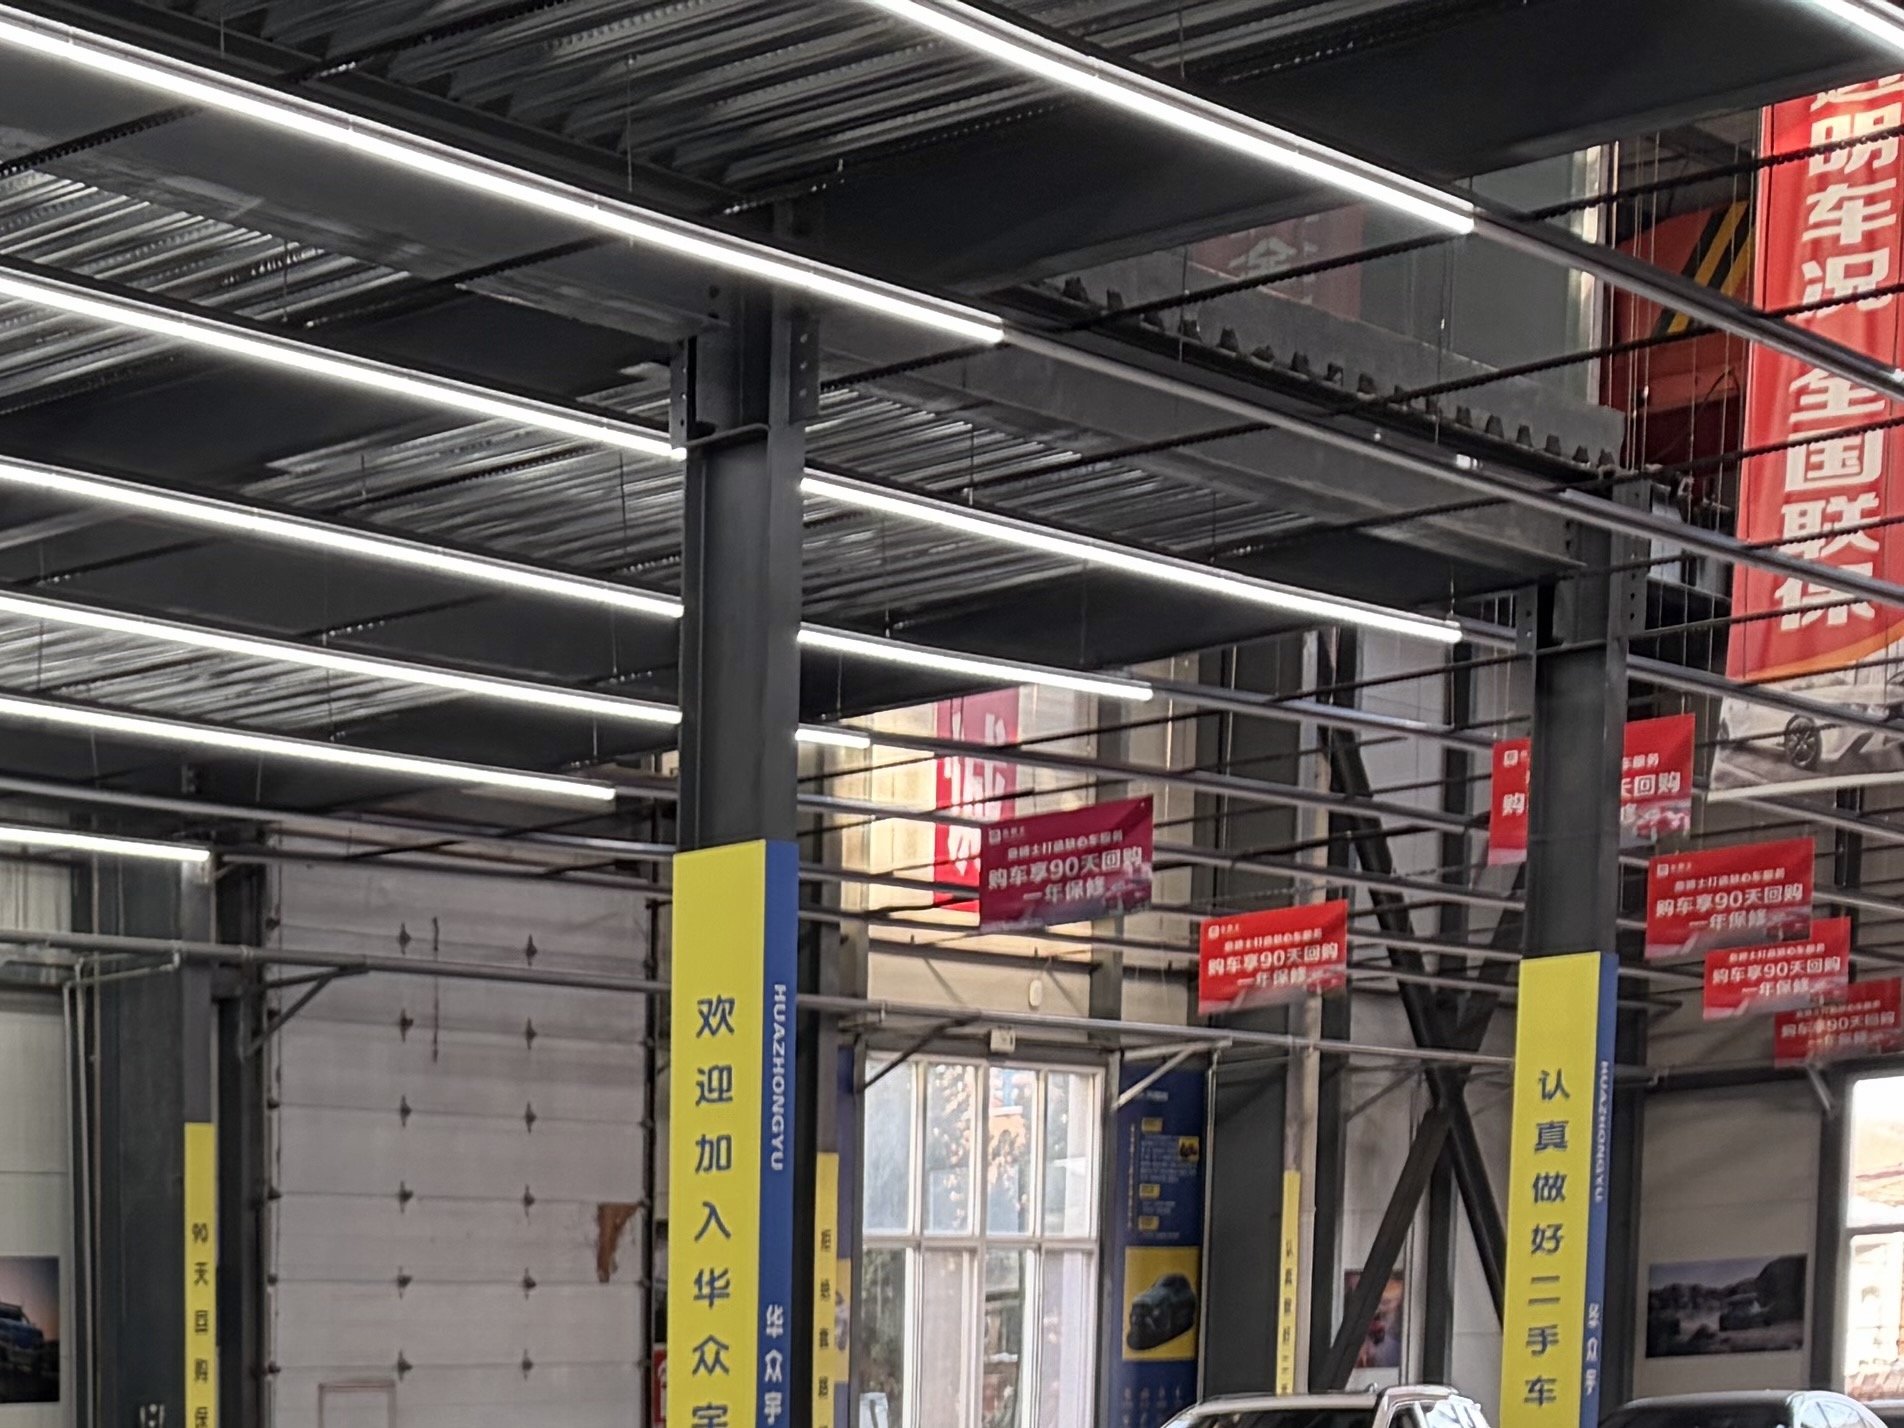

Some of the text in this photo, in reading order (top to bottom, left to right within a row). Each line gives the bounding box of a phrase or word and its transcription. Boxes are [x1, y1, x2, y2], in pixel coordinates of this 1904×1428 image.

[988, 845, 1143, 891] 购车享90天回购
[1654, 882, 1804, 918] 购车享90天回购
[1207, 941, 1339, 977] 购车享90天回购
[770, 984, 787, 1171] HUAZHONGYU
[1523, 1068, 1571, 1407] 认真做好二手车
[763, 1304, 785, 1426] 华众宇
